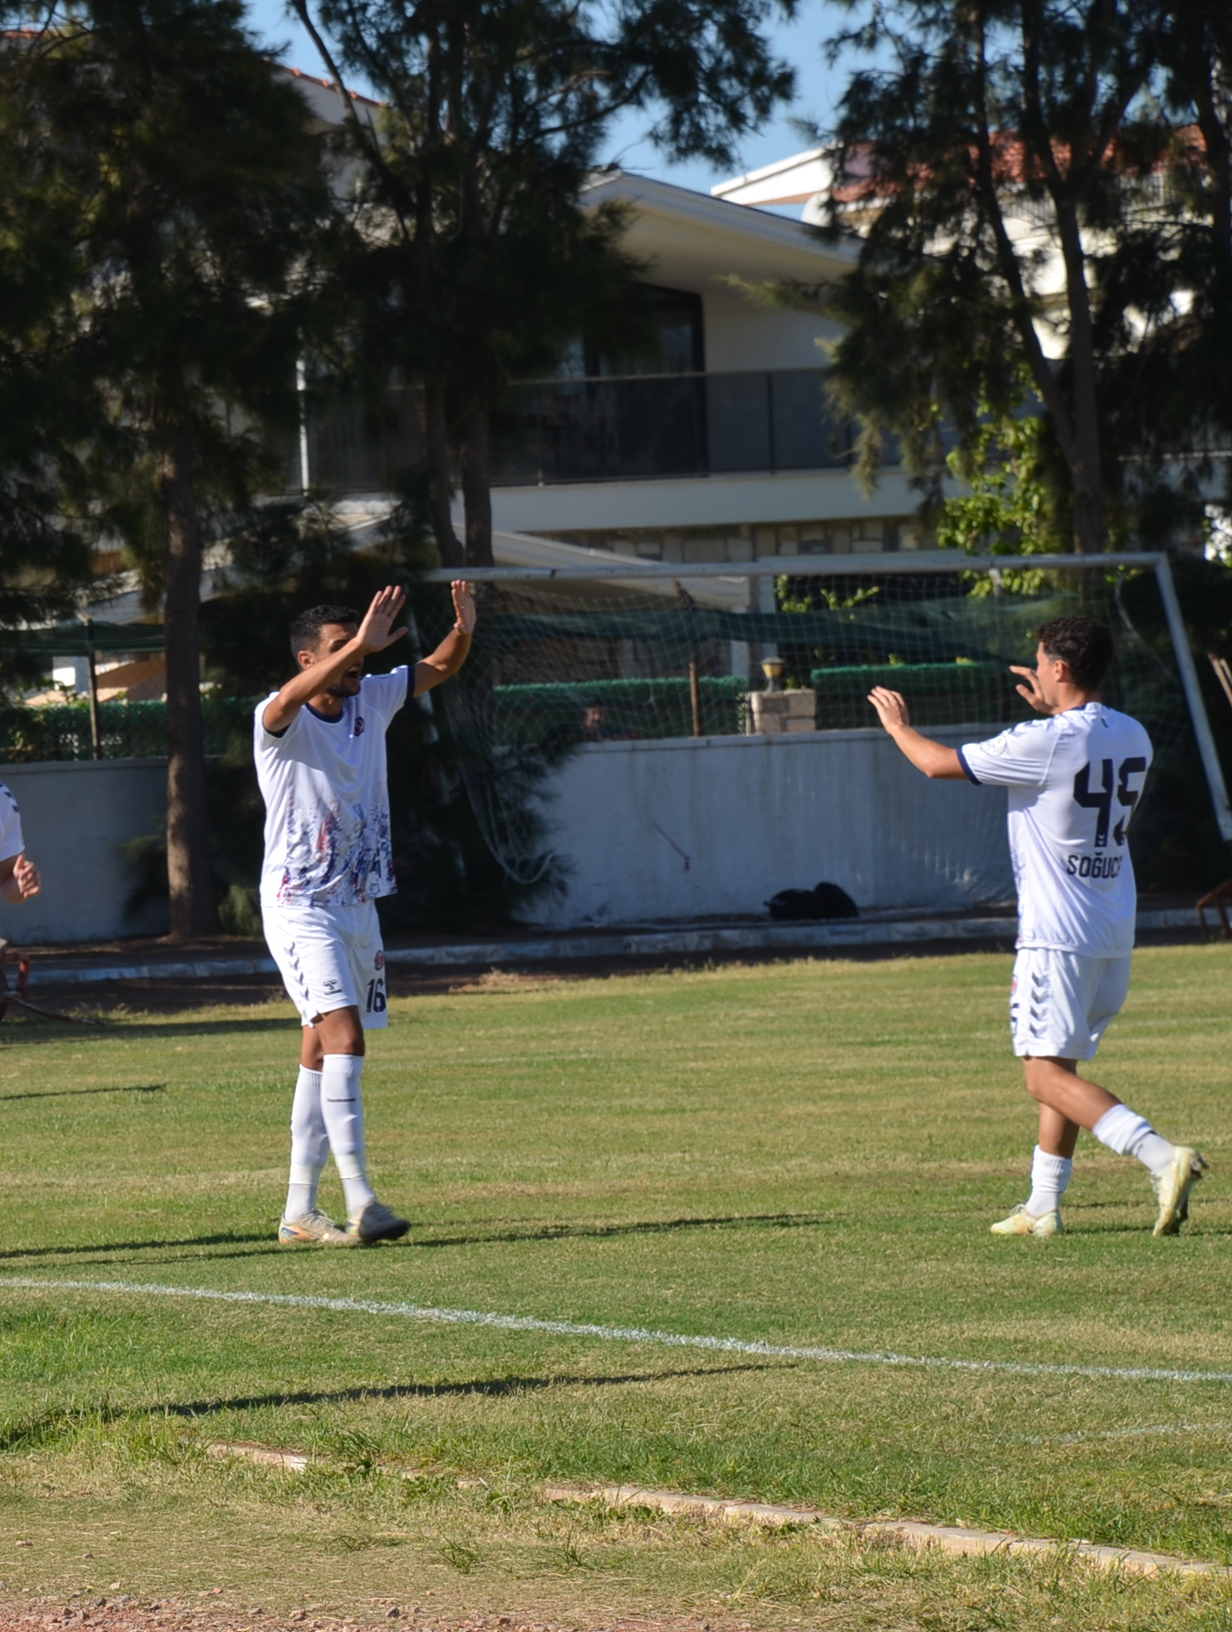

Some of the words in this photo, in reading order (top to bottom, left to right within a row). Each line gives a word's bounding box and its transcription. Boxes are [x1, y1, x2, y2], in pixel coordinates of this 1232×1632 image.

[1073, 757, 1146, 847] 45
[1067, 852, 1123, 879] SOĞUC
[366, 978, 386, 1013] 16
